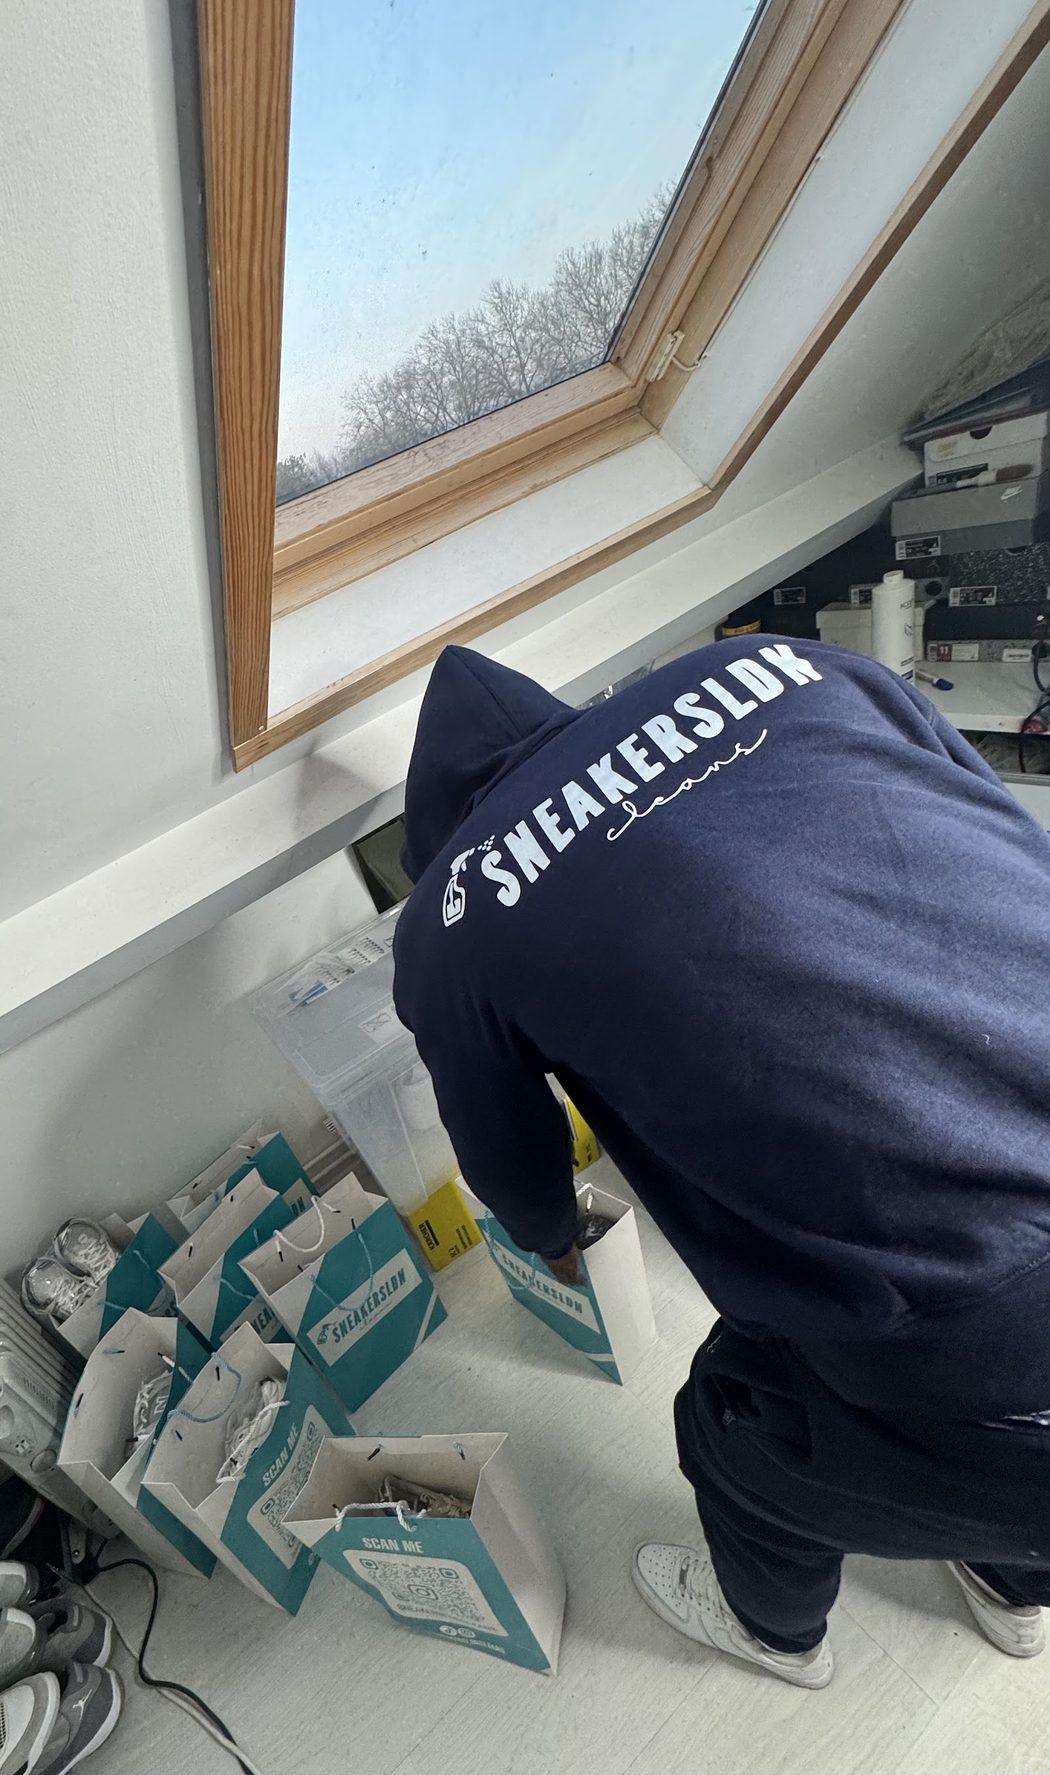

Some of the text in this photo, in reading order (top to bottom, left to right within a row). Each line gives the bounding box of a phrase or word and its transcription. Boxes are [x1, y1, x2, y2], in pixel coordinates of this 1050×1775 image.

[331, 1268, 407, 1343] SNEAKERSLDN
[262, 1423, 299, 1486] SCAN ME
[362, 1537, 424, 1554] SCAN ME
